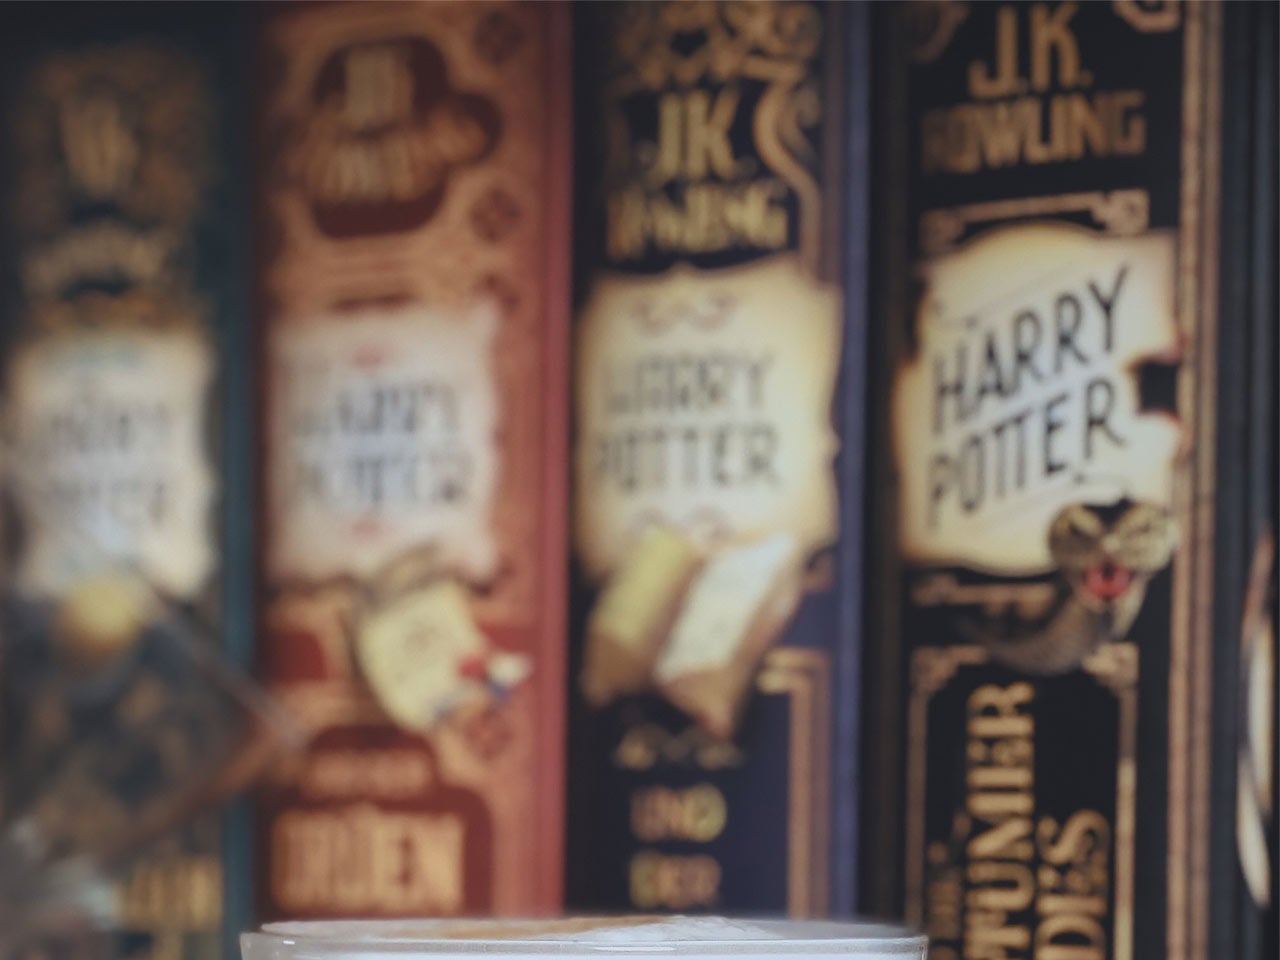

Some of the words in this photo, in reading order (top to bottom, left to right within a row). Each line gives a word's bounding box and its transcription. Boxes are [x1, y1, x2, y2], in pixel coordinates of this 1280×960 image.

[922, 90, 1146, 173] ROWLING
[930, 264, 1128, 438] HARRY
[926, 376, 1128, 530] POTTER
